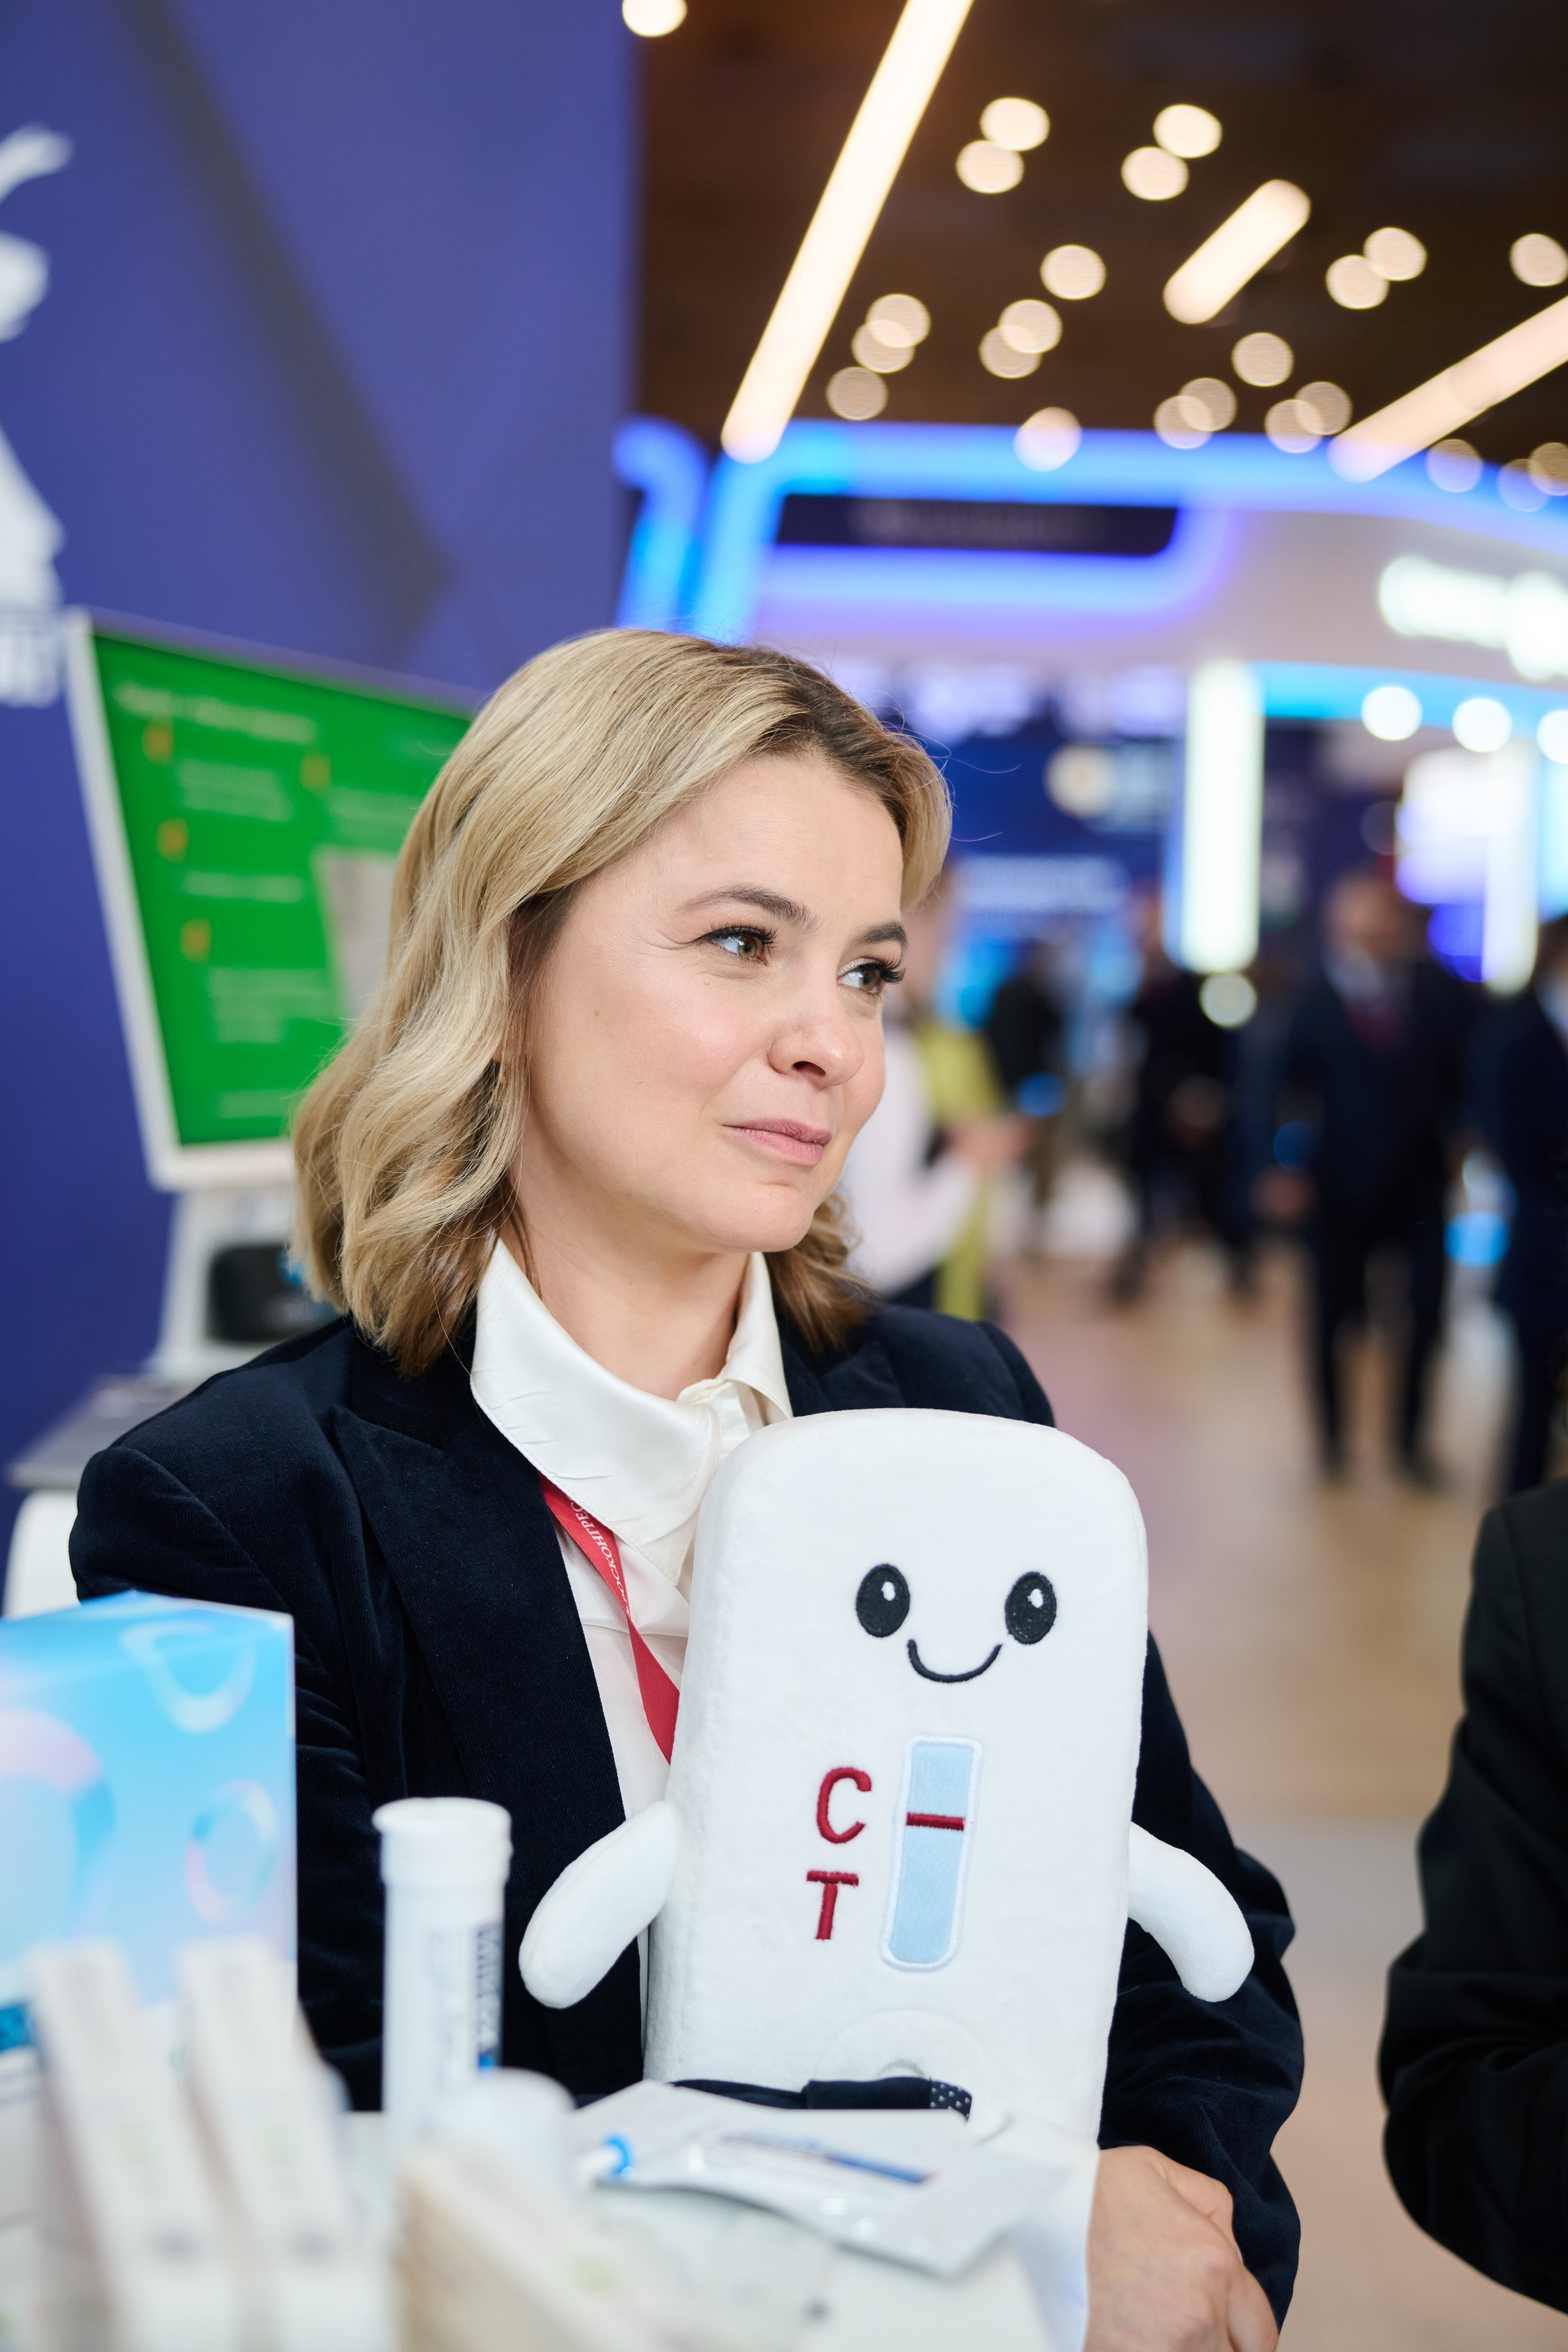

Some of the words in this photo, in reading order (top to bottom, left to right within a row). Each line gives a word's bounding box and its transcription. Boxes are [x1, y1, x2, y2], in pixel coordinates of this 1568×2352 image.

[567, 1496, 627, 1603] РОСКОНГРЕС
[816, 1767, 872, 1844] C
[807, 1871, 859, 1940] T
